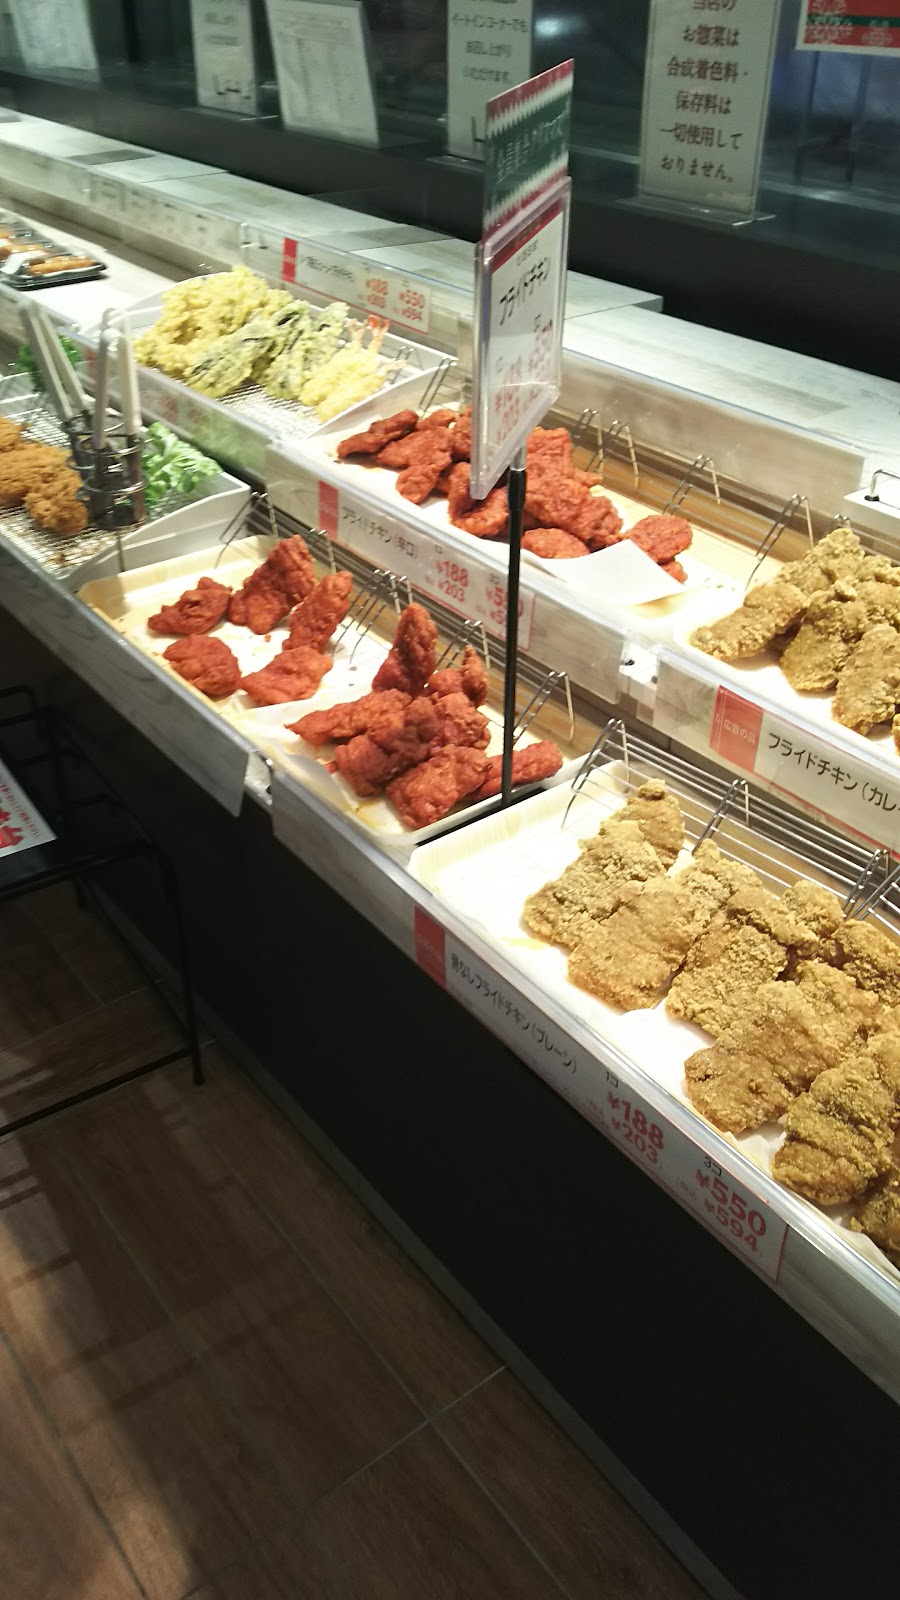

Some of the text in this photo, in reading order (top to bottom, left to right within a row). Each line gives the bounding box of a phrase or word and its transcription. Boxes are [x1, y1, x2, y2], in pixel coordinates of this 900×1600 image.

[682, 25, 740, 47] お惣菜は
[675, 90, 731, 115] 保存料は
[660, 122, 743, 149] 一切使用して
[661, 154, 733, 182] おりません。
[500, 256, 551, 327] フライドチキン
[436, 560, 468, 587] ¥188
[438, 580, 464, 602] ¥203
[606, 1071, 618, 1088] 1コ
[606, 1091, 664, 1150] ¥188
[704, 1156, 721, 1176] 3コ
[696, 1168, 766, 1237] ¥550
